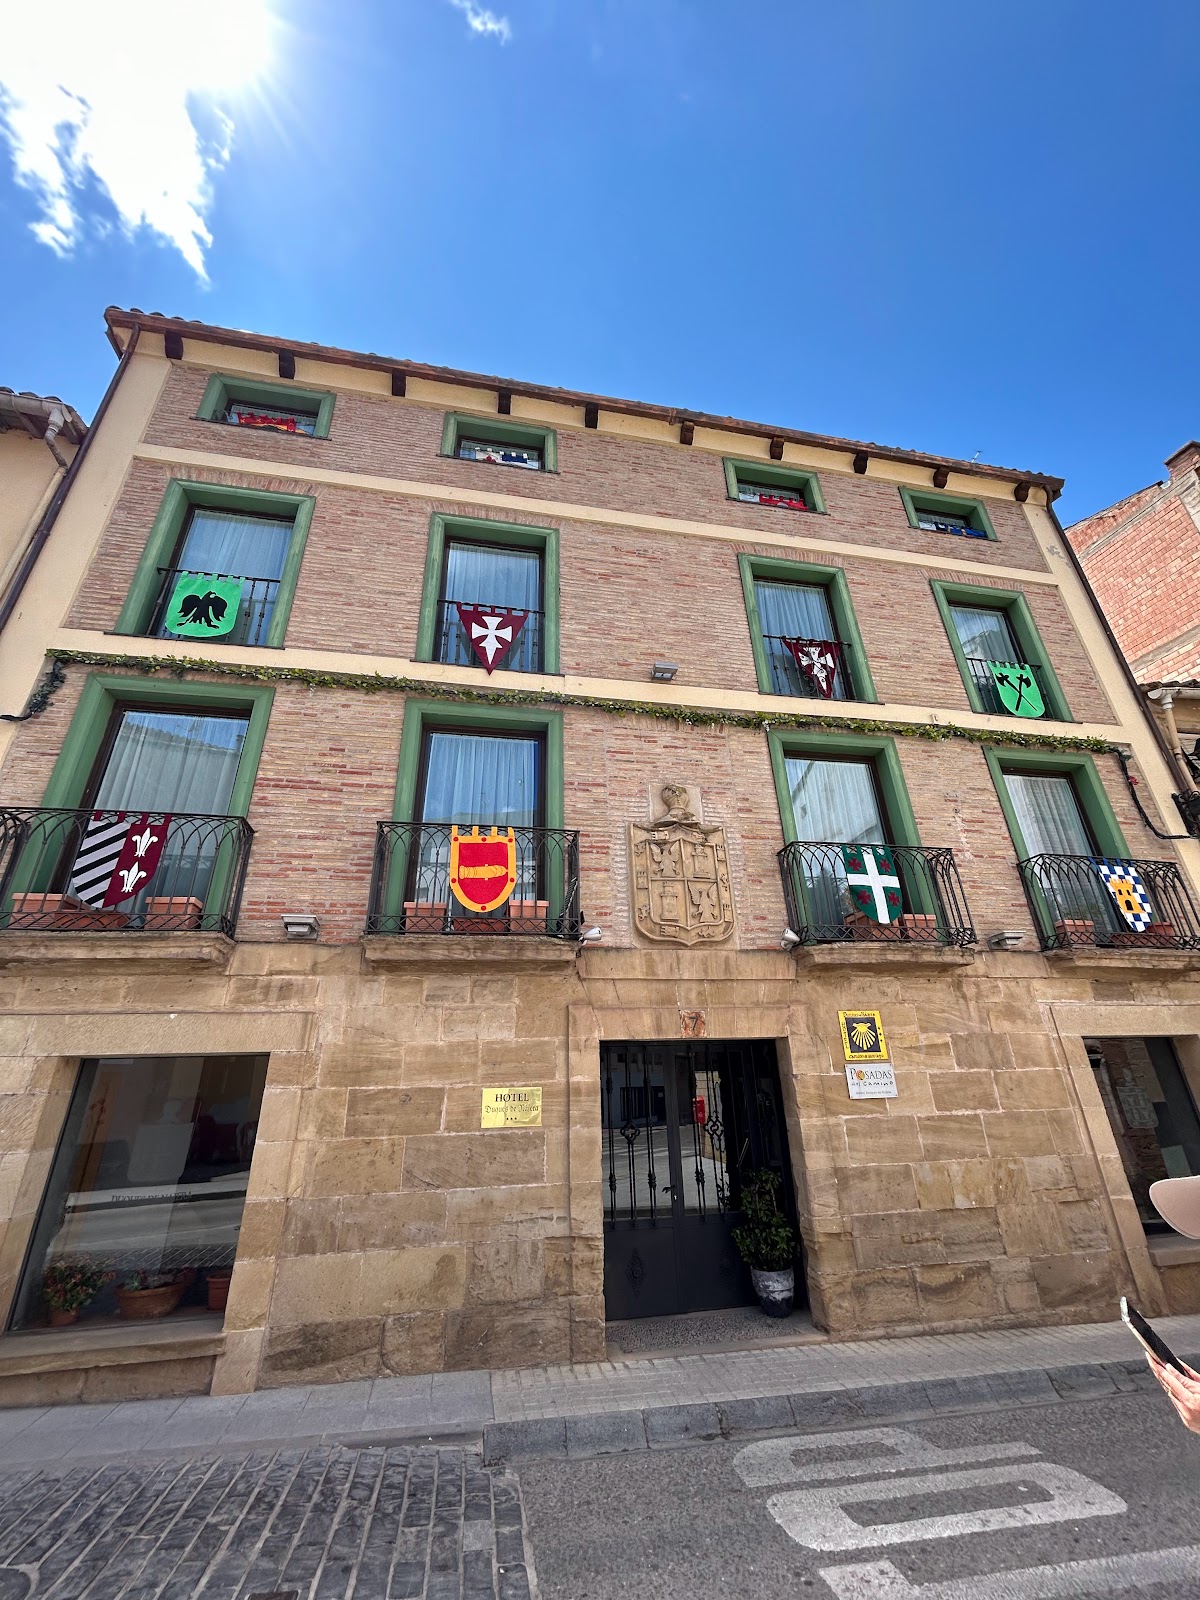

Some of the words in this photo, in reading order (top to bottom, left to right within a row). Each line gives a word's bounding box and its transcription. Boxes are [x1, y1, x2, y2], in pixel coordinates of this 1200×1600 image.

[688, 1011, 698, 1021] 7
[849, 1067, 893, 1081] POSADAS
[495, 1093, 529, 1102] HOTEL
